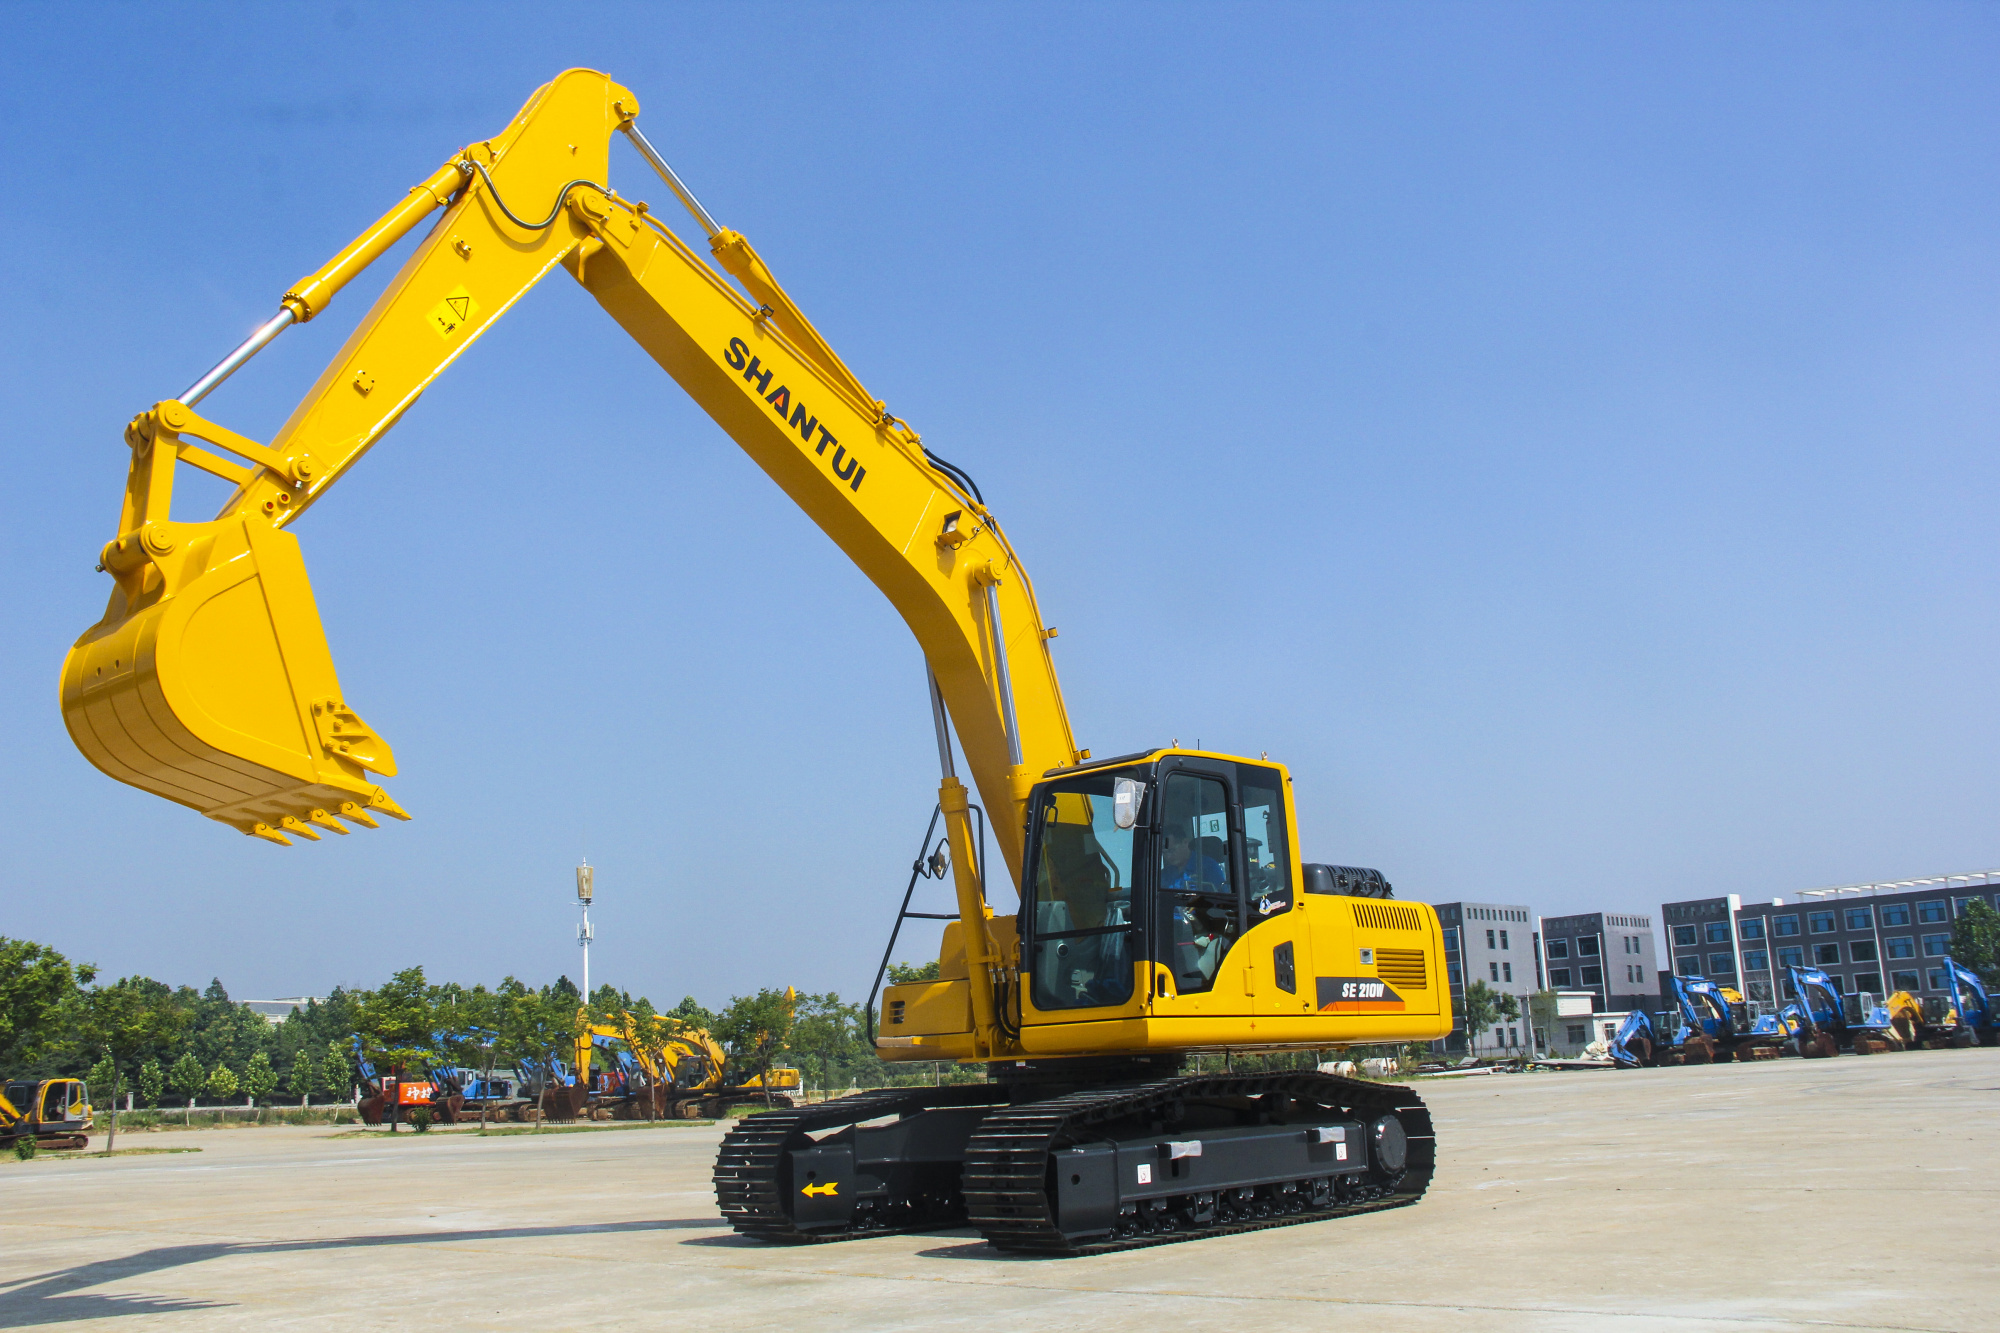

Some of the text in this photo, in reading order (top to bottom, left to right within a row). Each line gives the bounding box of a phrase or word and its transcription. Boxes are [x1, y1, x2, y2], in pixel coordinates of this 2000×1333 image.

[724, 336, 867, 493] SHANTUI
[1341, 982, 1385, 998] SE 210W
